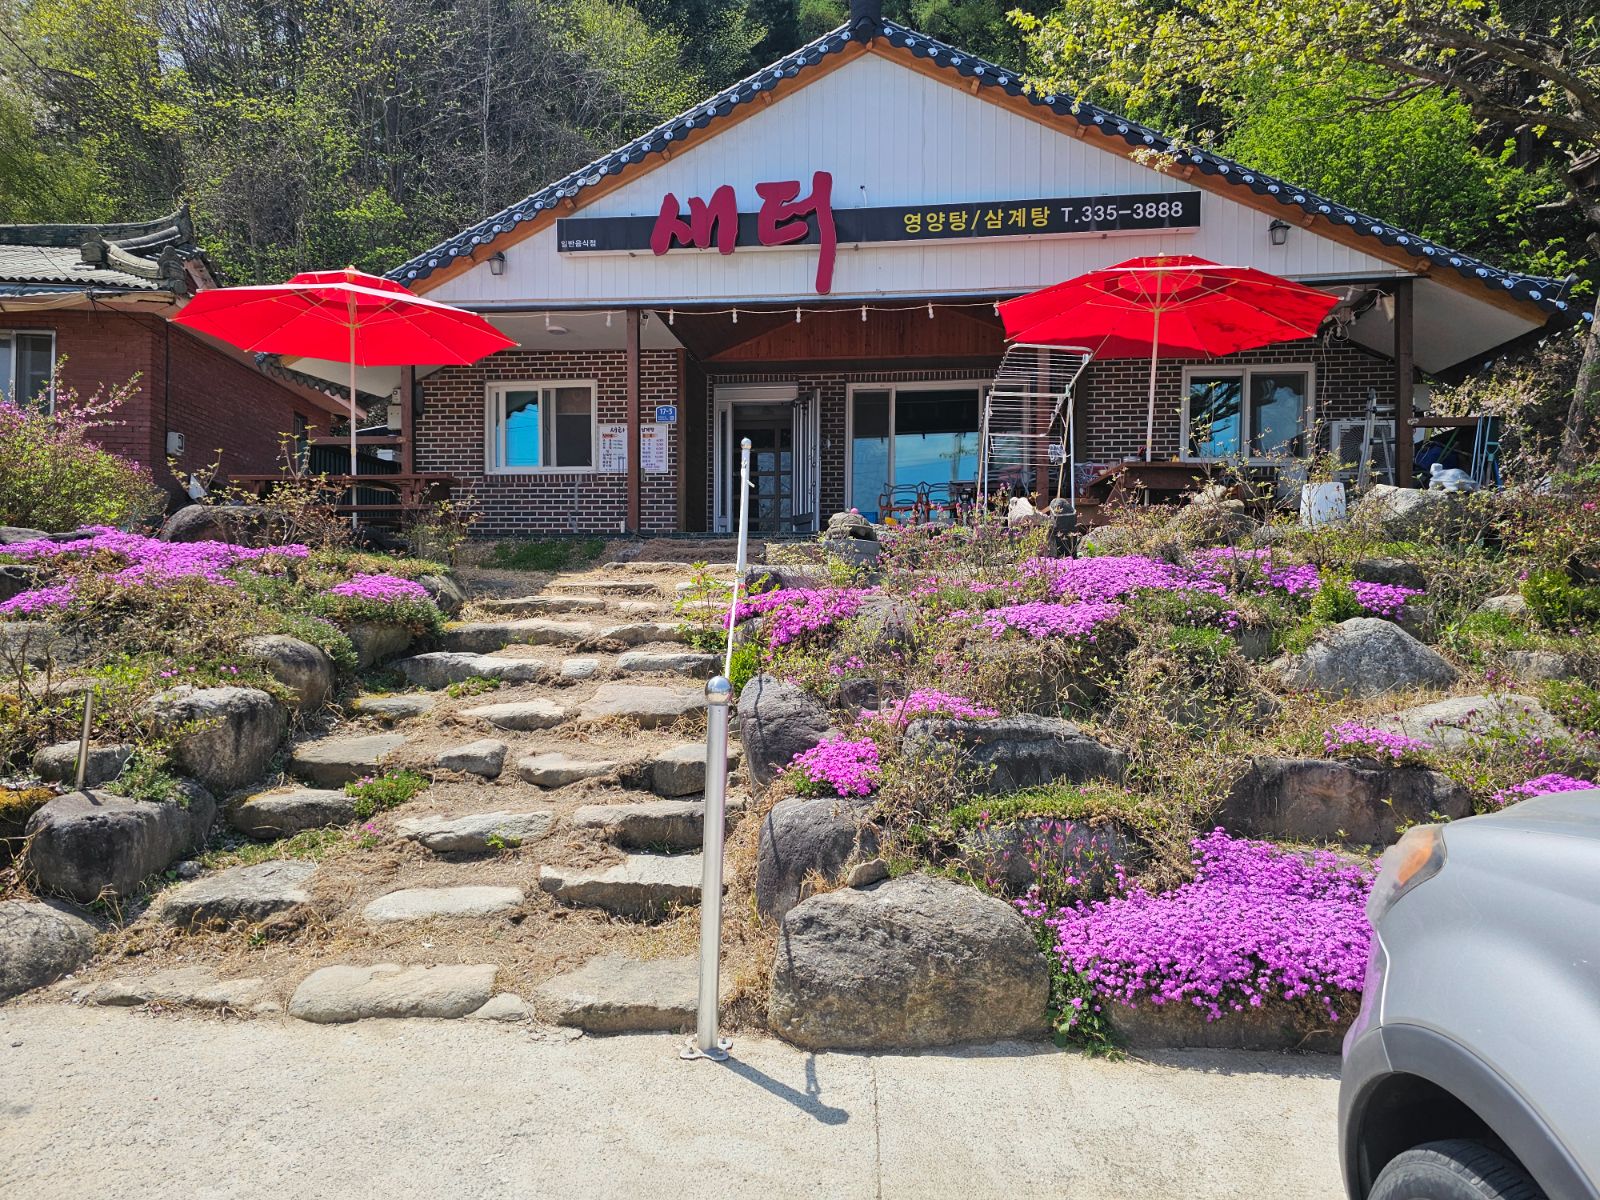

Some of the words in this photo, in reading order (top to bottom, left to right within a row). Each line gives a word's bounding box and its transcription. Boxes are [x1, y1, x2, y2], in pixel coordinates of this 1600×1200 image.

[650, 171, 837, 295] 새터
[903, 206, 1050, 233] 영양탕/삼계탕
[1061, 201, 1184, 225] T.335-3888
[560, 239, 597, 248] 일반음식점
